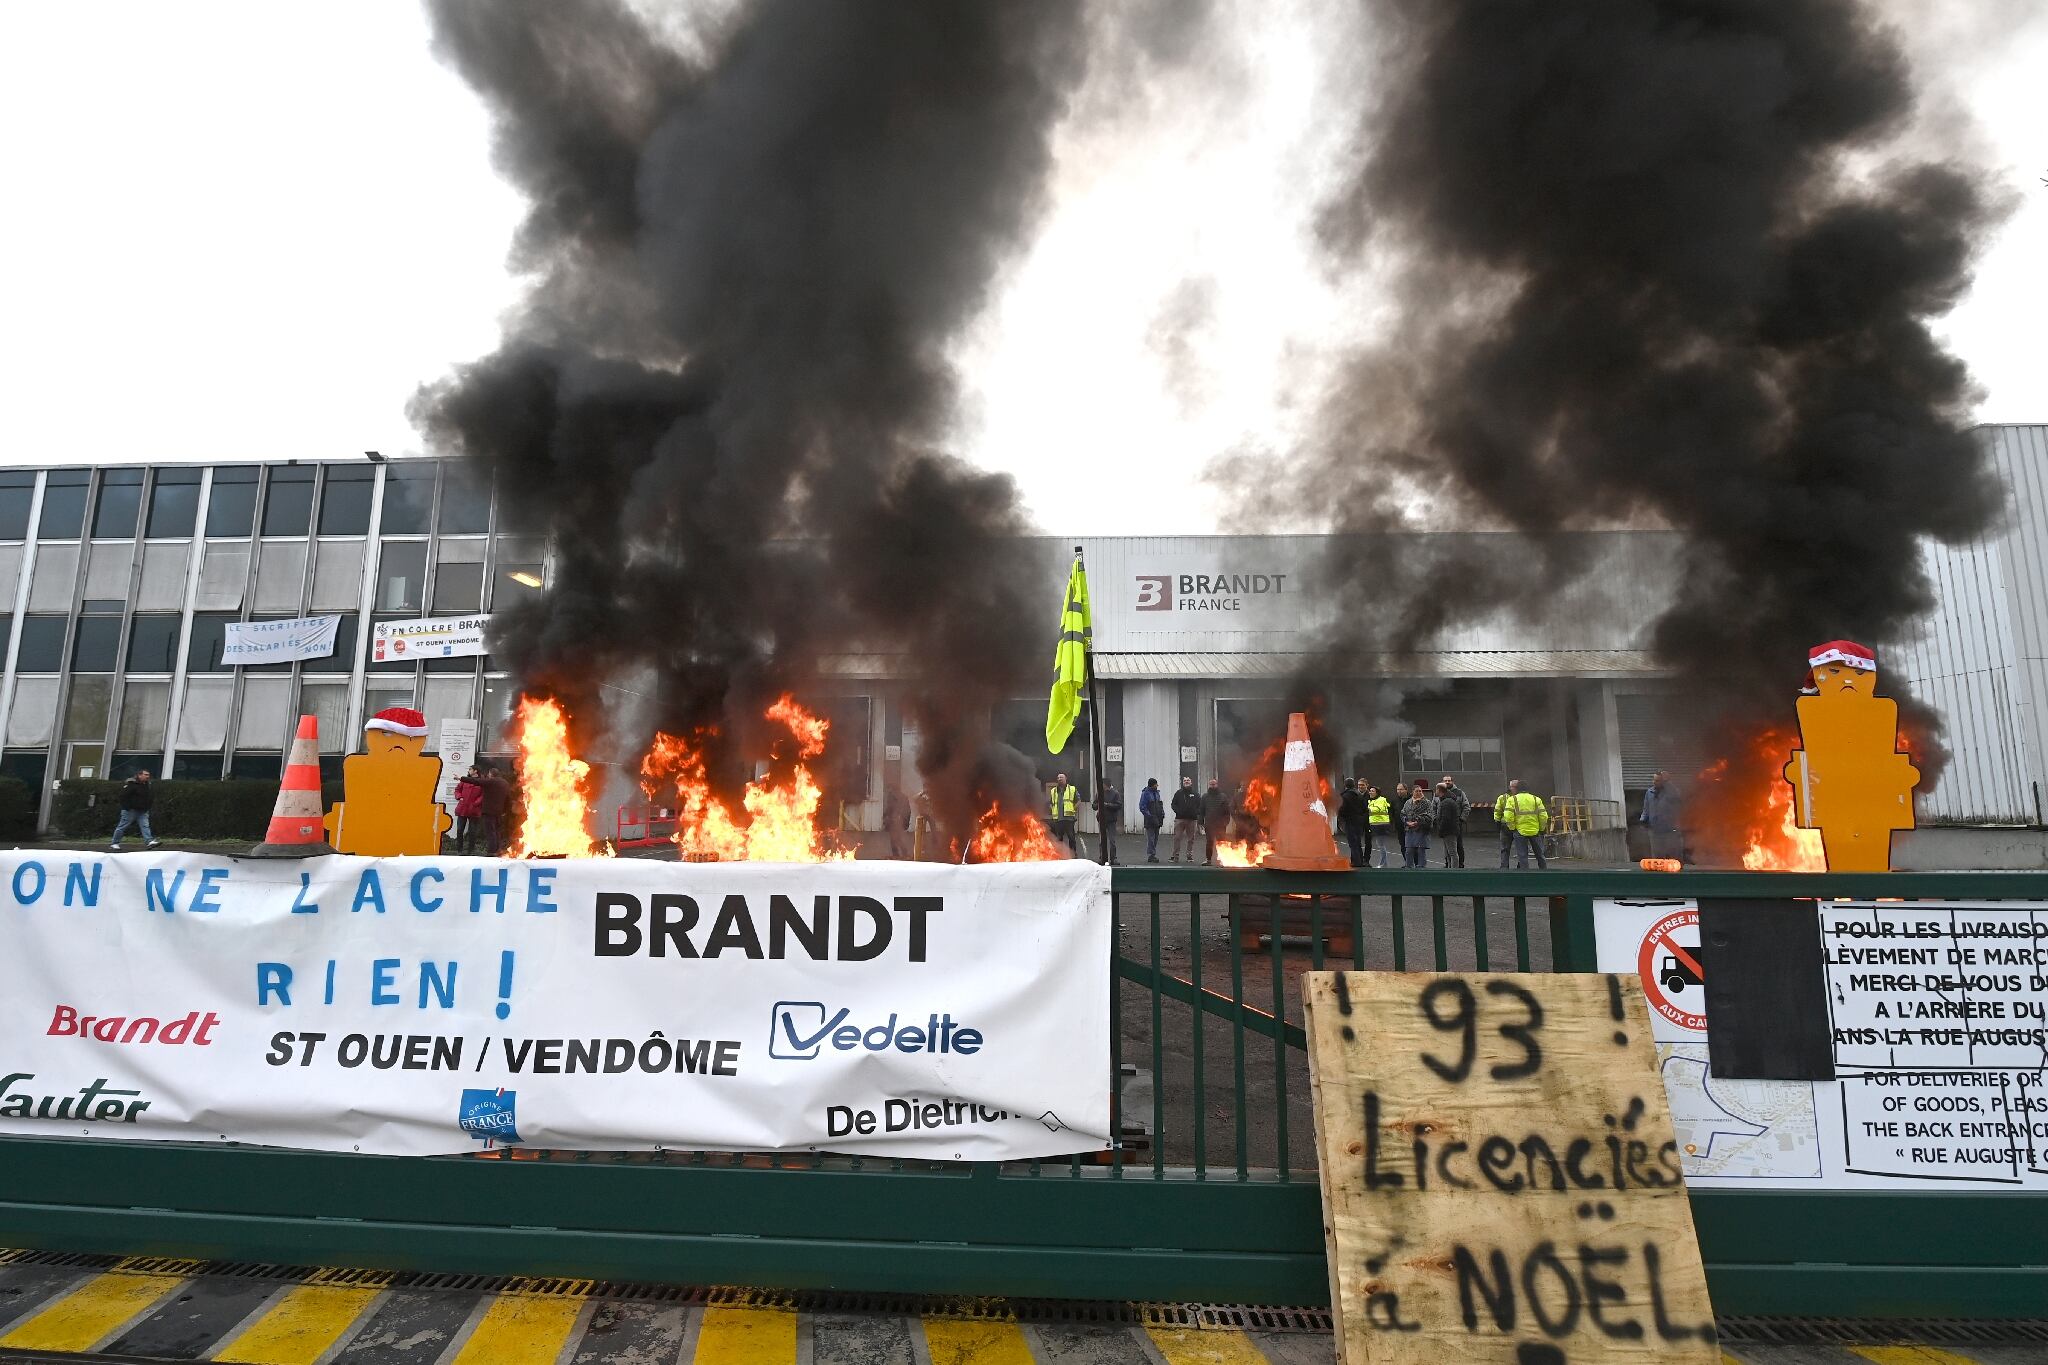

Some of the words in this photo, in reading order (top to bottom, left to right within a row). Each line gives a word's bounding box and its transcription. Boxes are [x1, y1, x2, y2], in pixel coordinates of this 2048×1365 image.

[1179, 574, 1287, 595] BRANDT
[1179, 598, 1241, 611] FRANCE
[12, 859, 102, 908] ON
[145, 867, 230, 914] NE
[290, 867, 559, 914] LACHE
[594, 891, 944, 963] BRANDT
[1648, 915, 1687, 945] ENTREE
[1834, 921, 1895, 939] POUR
[1902, 921, 1942, 939] LES
[1946, 948, 1977, 965] DE
[1984, 948, 2048, 966] MARC
[1850, 974, 1917, 992] MERCI
[1924, 974, 1955, 992] DE
[1961, 974, 2022, 992] VOUS
[1659, 1003, 1684, 1024] AUX
[1687, 1018, 1708, 1028] CA
[1874, 1001, 1890, 1019] A
[2013, 1001, 2044, 1019] DU
[46, 1004, 221, 1046] Brandt
[780, 1007, 984, 1056] Vedette
[1418, 976, 1545, 1084] 93
[1885, 1027, 1914, 1045] LA
[1920, 1028, 1964, 1046] RUE
[1972, 1028, 2048, 1046] AUGUS
[265, 1031, 326, 1067] ST
[337, 1032, 464, 1072] OUEN
[474, 1036, 491, 1073] /
[502, 1030, 742, 1077] VENDÔME
[1864, 1071, 1901, 1087] FOR
[1907, 1071, 2011, 1088] DELIVERIES
[2016, 1072, 2044, 1088] OR
[468, 1101, 502, 1117] ORIGINE
[1882, 1096, 1907, 1112] OF
[1913, 1096, 1985, 1116] GOODS,
[461, 1112, 514, 1130] FRANCE
[826, 1105, 877, 1138] De
[1862, 1121, 1899, 1138] THE
[1905, 1121, 1955, 1138] BACK
[1361, 1088, 1684, 1193] Licenciés
[1912, 1147, 1949, 1164] RUE
[1954, 1147, 2038, 1164] AUGUSTE
[1451, 1201, 1720, 1345] NOËL
